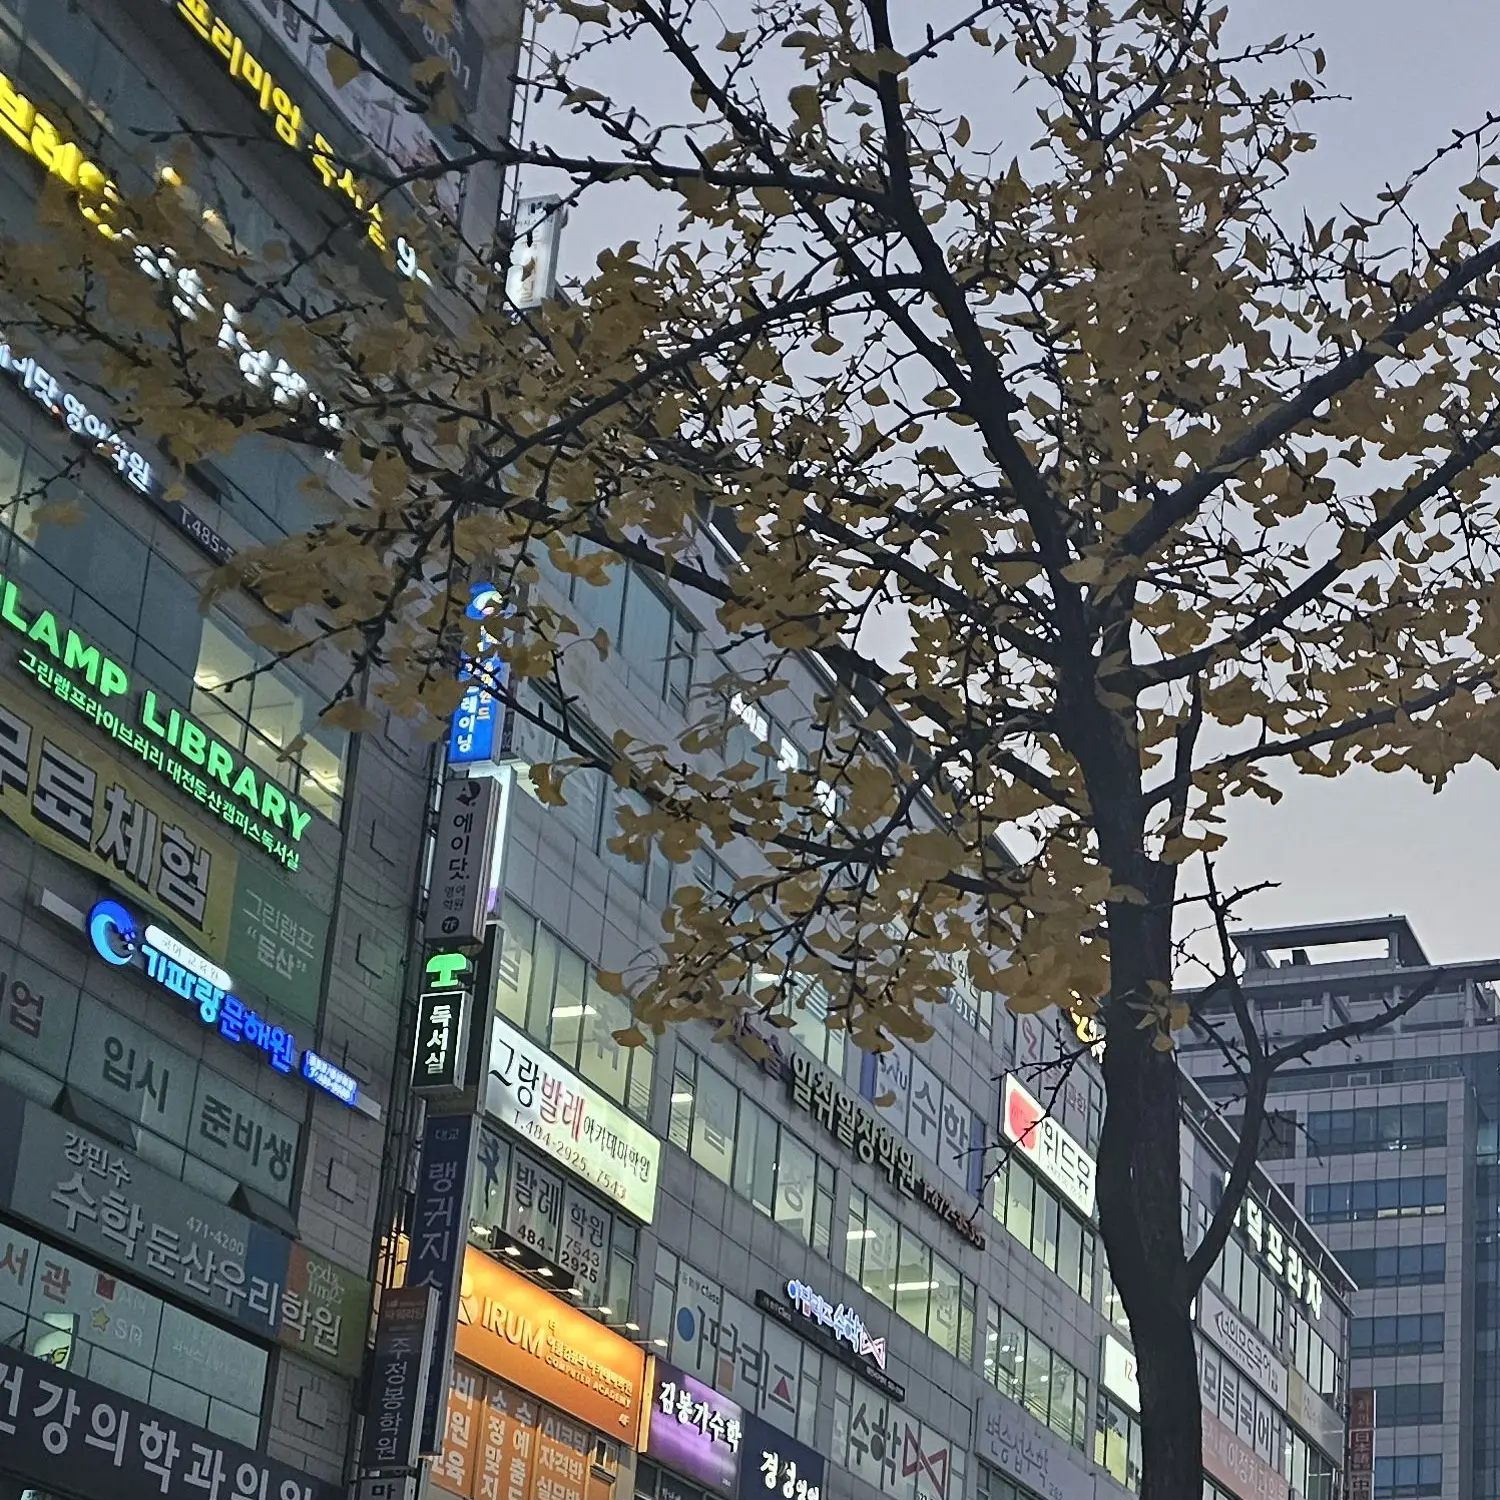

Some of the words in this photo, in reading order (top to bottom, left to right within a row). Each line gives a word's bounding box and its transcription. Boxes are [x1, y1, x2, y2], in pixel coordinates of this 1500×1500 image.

[2, 581, 129, 698] LAMP
[141, 688, 312, 842] LIBRARY
[102, 1035, 169, 1113] 입시
[423, 1003, 453, 1075] 독서실
[63, 1131, 132, 1187] 강민수
[200, 1094, 294, 1183] 준비생
[790, 1051, 919, 1200] 일취월장학원
[911, 1081, 970, 1176] 수학
[51, 1170, 145, 1259] 수학
[513, 1156, 562, 1228] 발레
[570, 1204, 607, 1249] 학원
[560, 1252, 599, 1284] 2925
[481, 1296, 546, 1360] IRUM
[544, 1354, 592, 1388] COMPUTER
[592, 1381, 632, 1409] ACADEMY
[538, 1443, 585, 1485] 자격반
[849, 1401, 902, 1487] 수학
